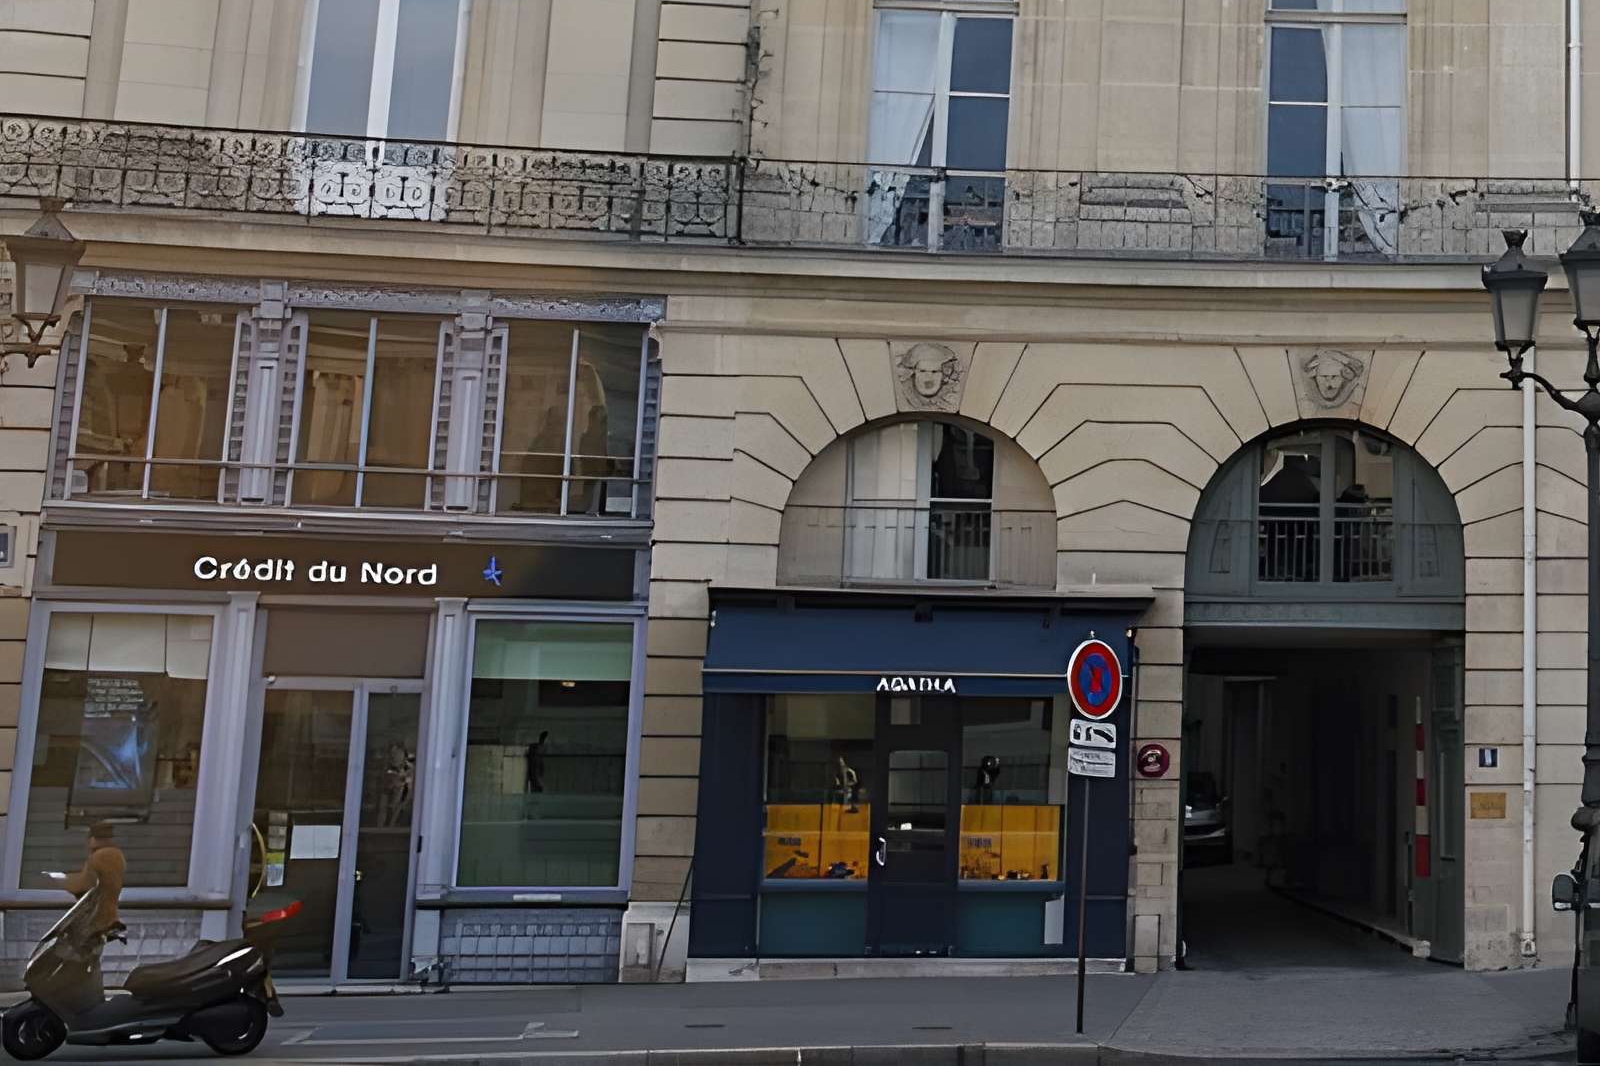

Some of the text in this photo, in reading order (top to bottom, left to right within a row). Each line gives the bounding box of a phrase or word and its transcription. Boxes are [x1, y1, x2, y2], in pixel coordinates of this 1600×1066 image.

[194, 556, 437, 585] Crédit du Nord
